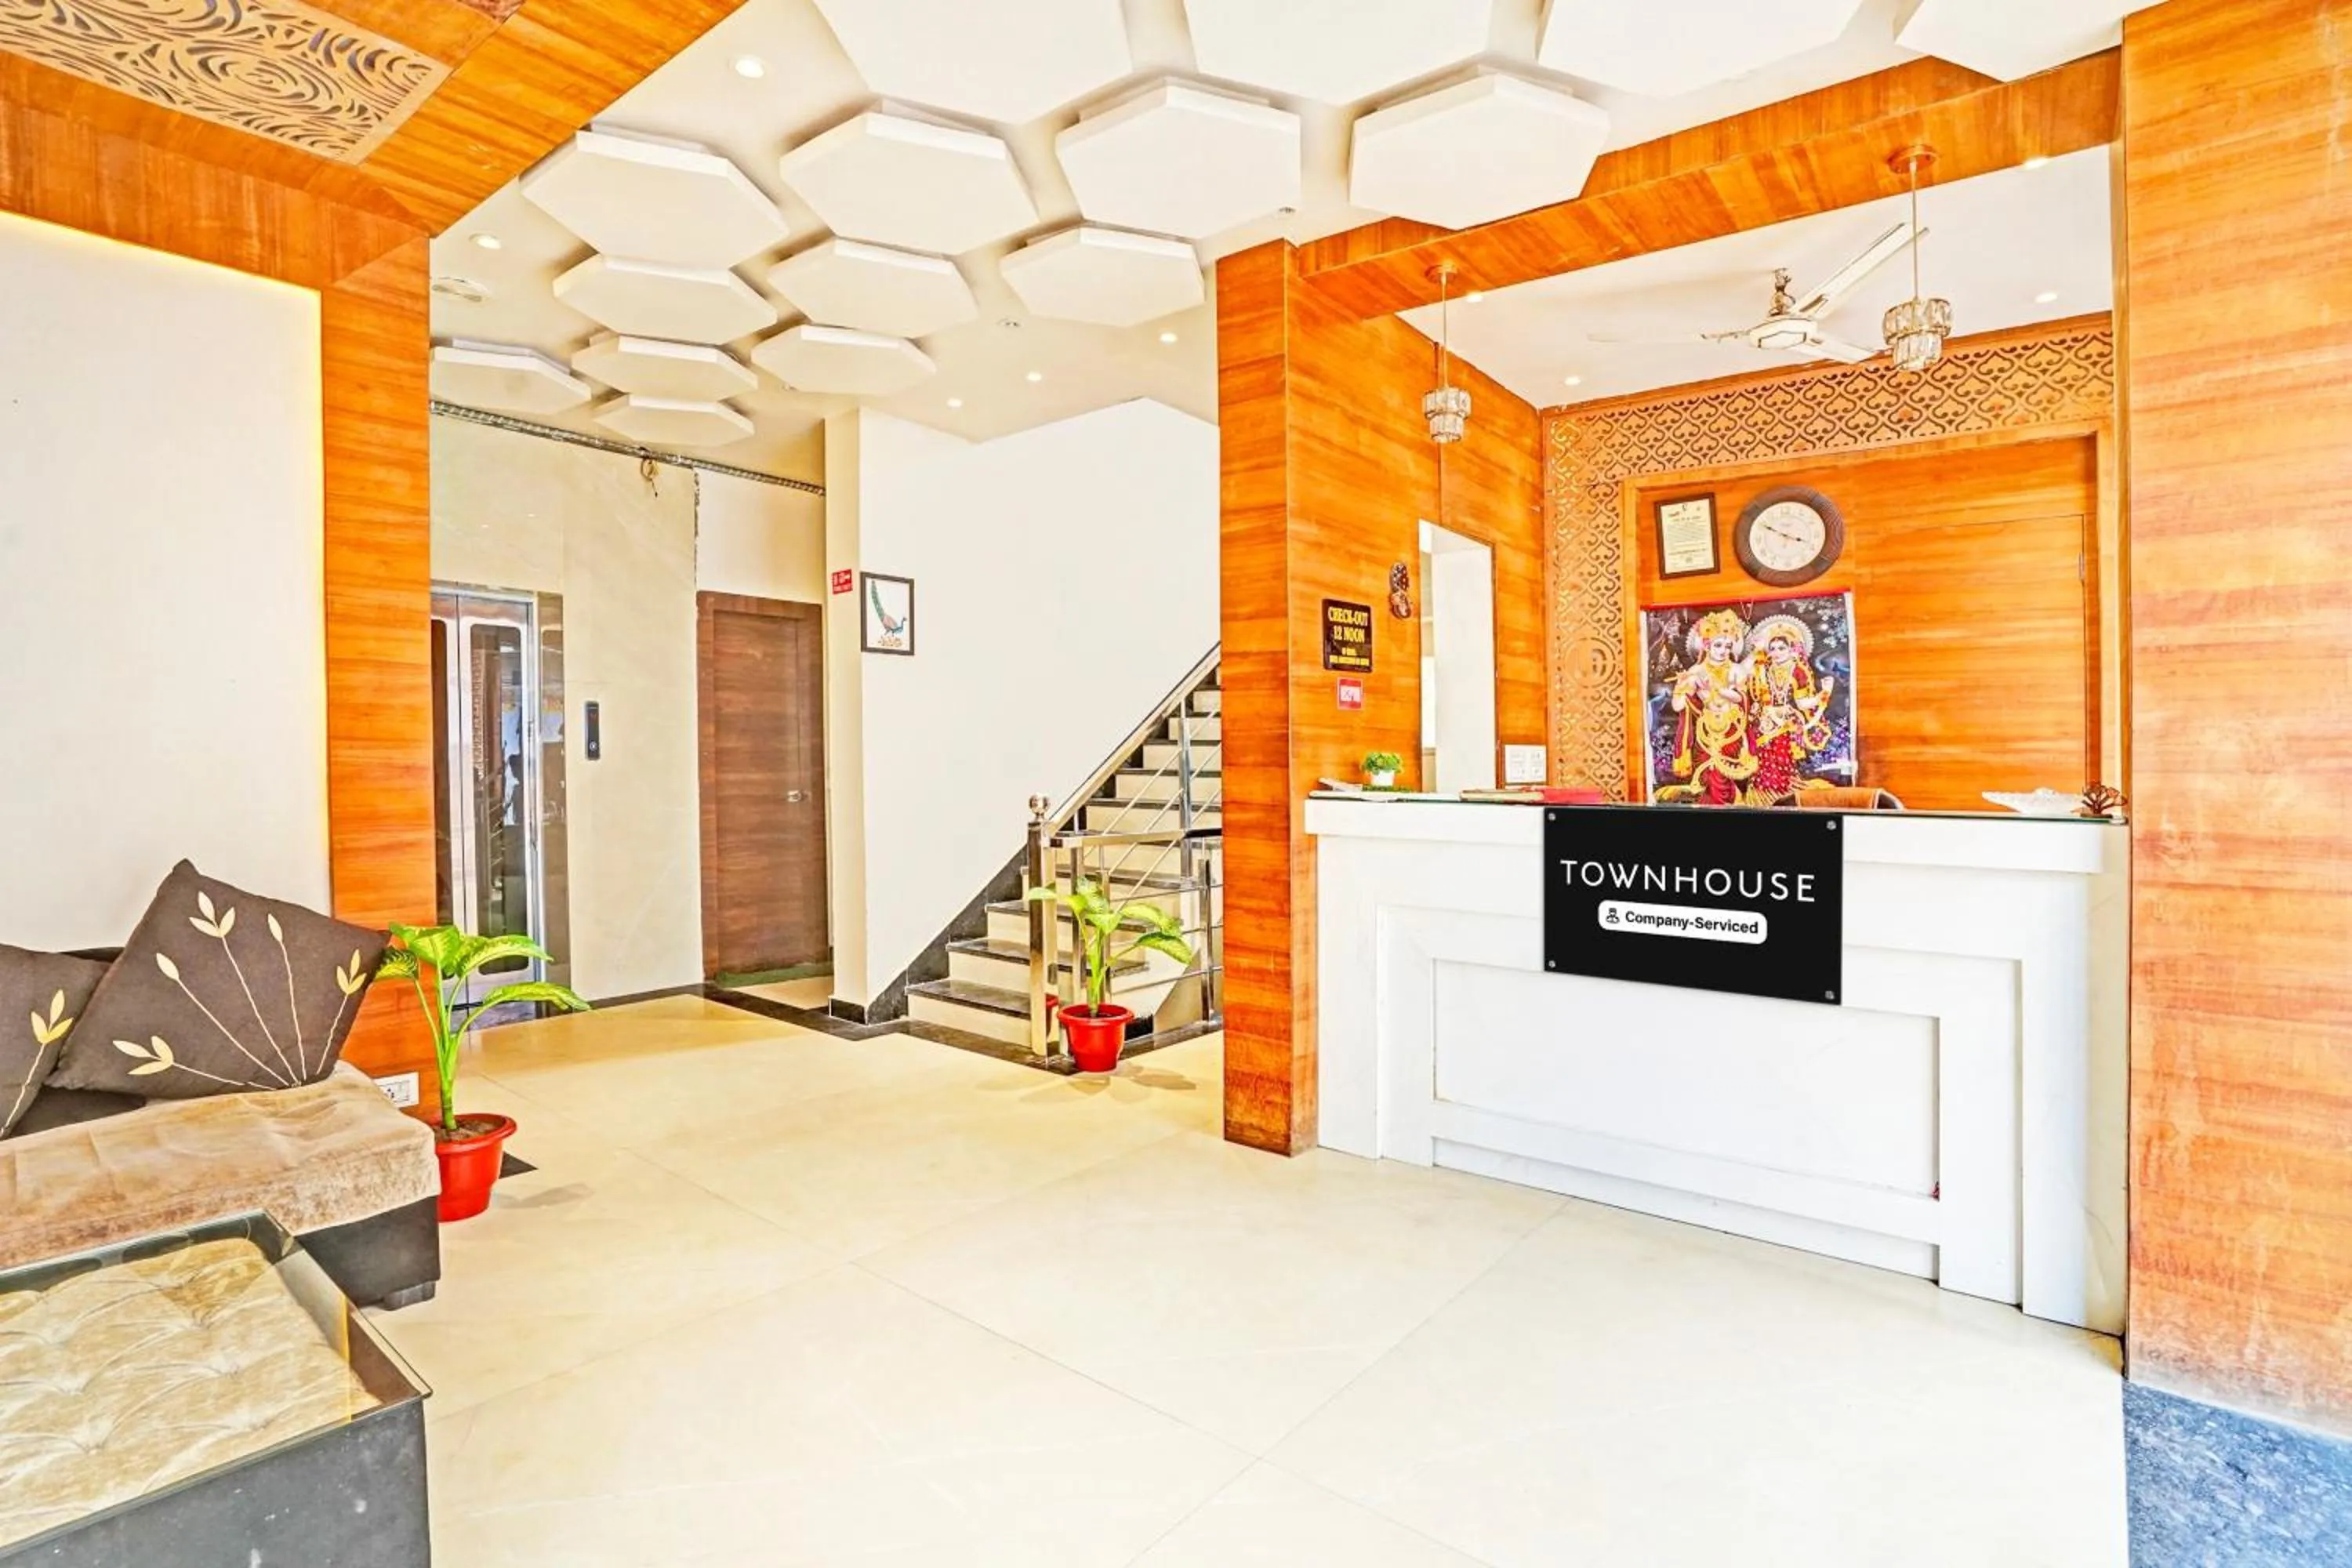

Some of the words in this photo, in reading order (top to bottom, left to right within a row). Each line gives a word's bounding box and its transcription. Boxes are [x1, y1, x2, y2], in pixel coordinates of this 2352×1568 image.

[1328, 607, 1368, 626] CHECK-OUT
[1334, 626, 1342, 641] 12
[1344, 627, 1365, 643] NOON
[1560, 859, 1815, 902] TOWNHOUSE
[1625, 910, 1759, 935] Company-Serviced
